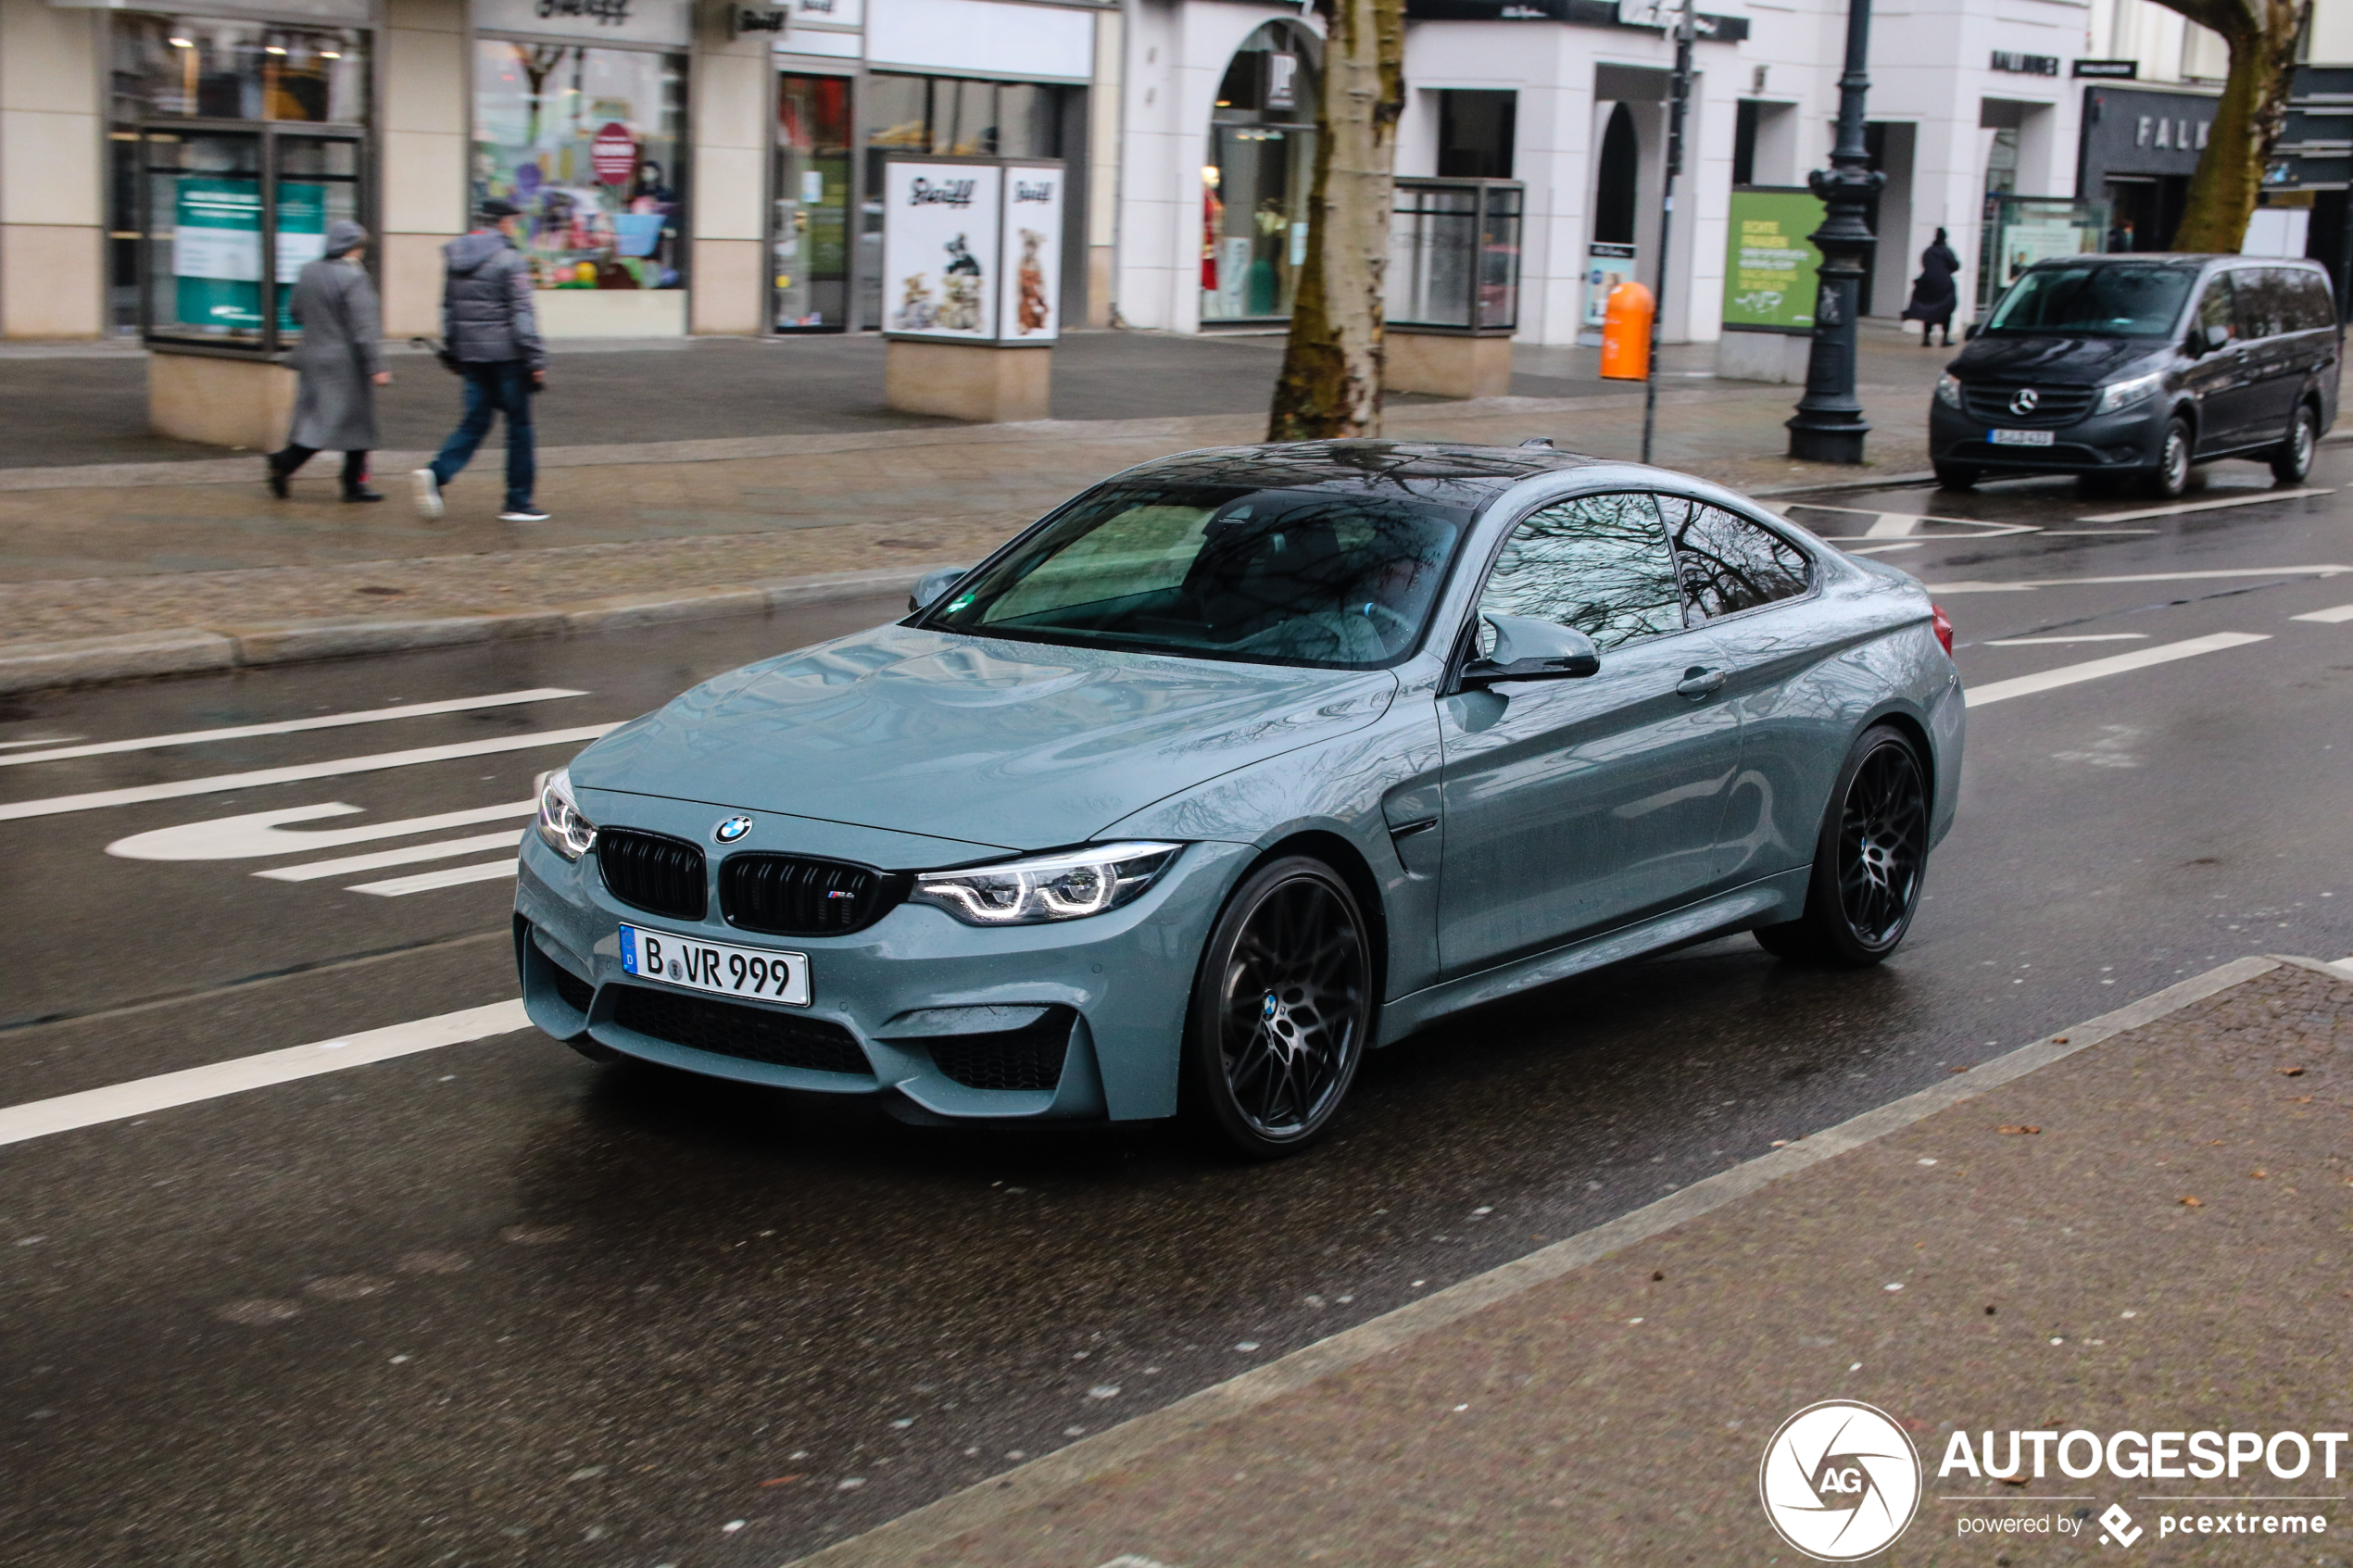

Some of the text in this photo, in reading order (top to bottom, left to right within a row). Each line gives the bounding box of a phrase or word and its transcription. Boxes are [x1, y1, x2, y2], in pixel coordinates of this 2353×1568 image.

[626, 954, 634, 965] D
[645, 936, 789, 996] B VR 999
